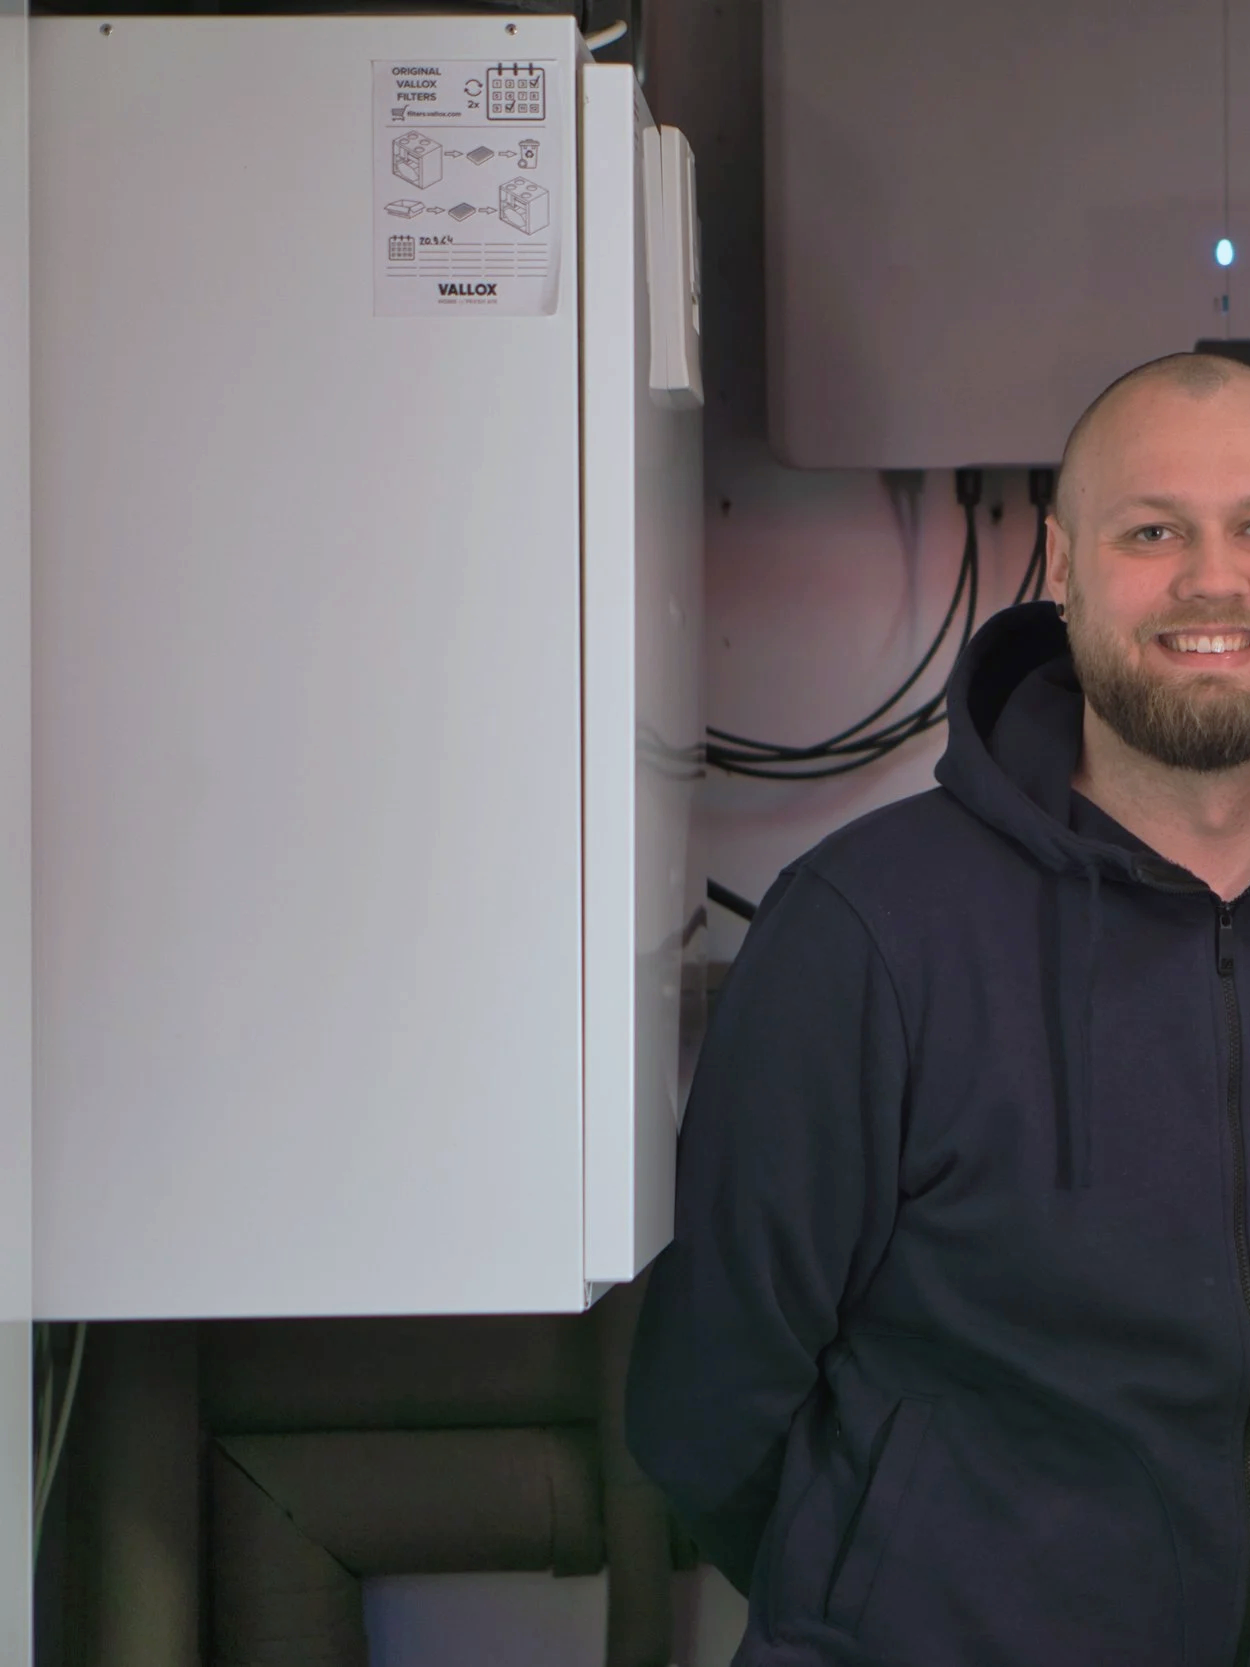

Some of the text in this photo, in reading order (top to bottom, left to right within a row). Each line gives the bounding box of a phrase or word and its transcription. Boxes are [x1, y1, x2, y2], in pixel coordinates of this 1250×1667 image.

[392, 67, 442, 76] ORIGINAL
[396, 80, 437, 89] VALLOX
[397, 92, 437, 101] FILTERS
[468, 100, 480, 109] 2x
[438, 283, 498, 296] VALLOX
